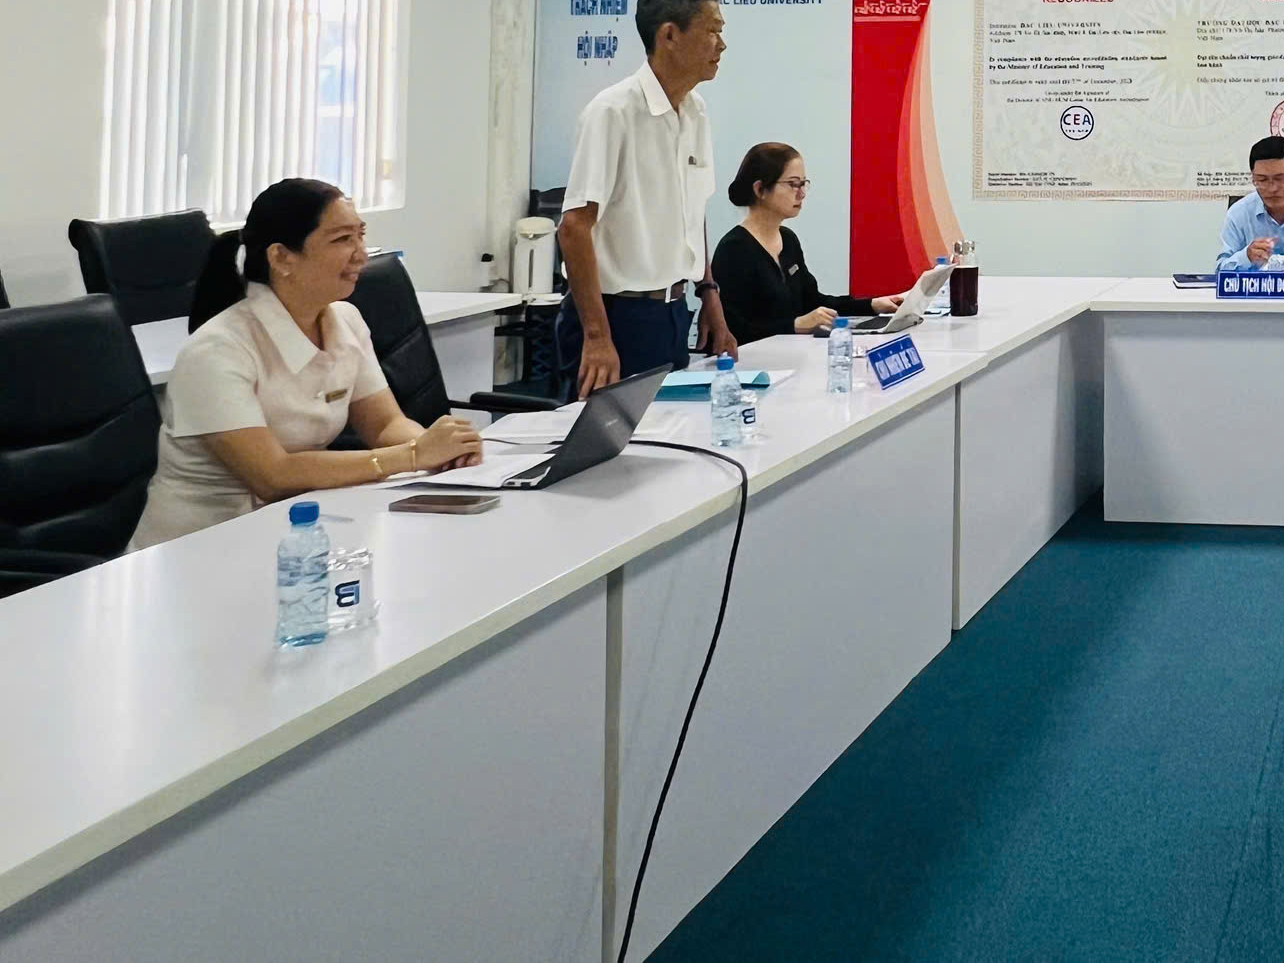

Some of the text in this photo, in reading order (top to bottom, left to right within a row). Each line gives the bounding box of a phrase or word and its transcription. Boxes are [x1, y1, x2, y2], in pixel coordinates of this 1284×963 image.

[1063, 113, 1092, 125] CEA
[1224, 273, 1240, 292] CHỦ
[1242, 277, 1259, 296] TỊCH
[1261, 275, 1275, 295] HỘI
